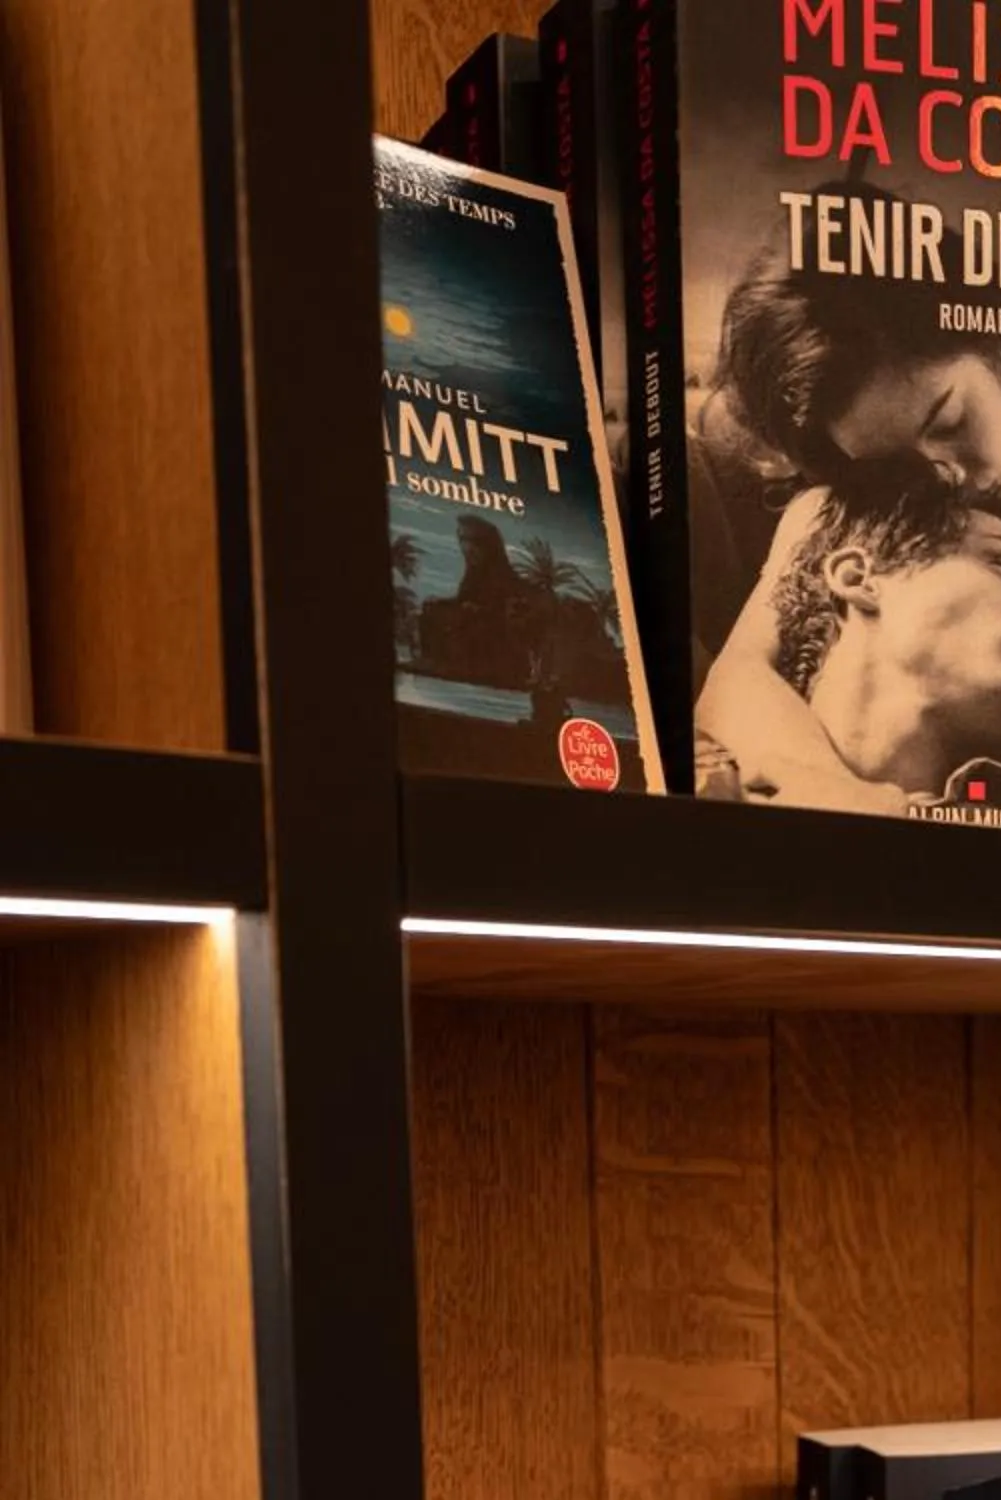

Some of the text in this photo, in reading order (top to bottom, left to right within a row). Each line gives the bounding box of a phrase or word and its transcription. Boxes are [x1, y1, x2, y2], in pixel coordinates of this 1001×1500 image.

[783, 75, 892, 166] DA
[442, 194, 517, 231] TEMPS
[780, 191, 945, 284] TENIR
[384, 401, 568, 493] MITT
[644, 351, 663, 520] TENIR DEBOUT
[408, 472, 525, 517] sombre
[567, 759, 616, 782] Poche
[568, 736, 608, 758] Livre
